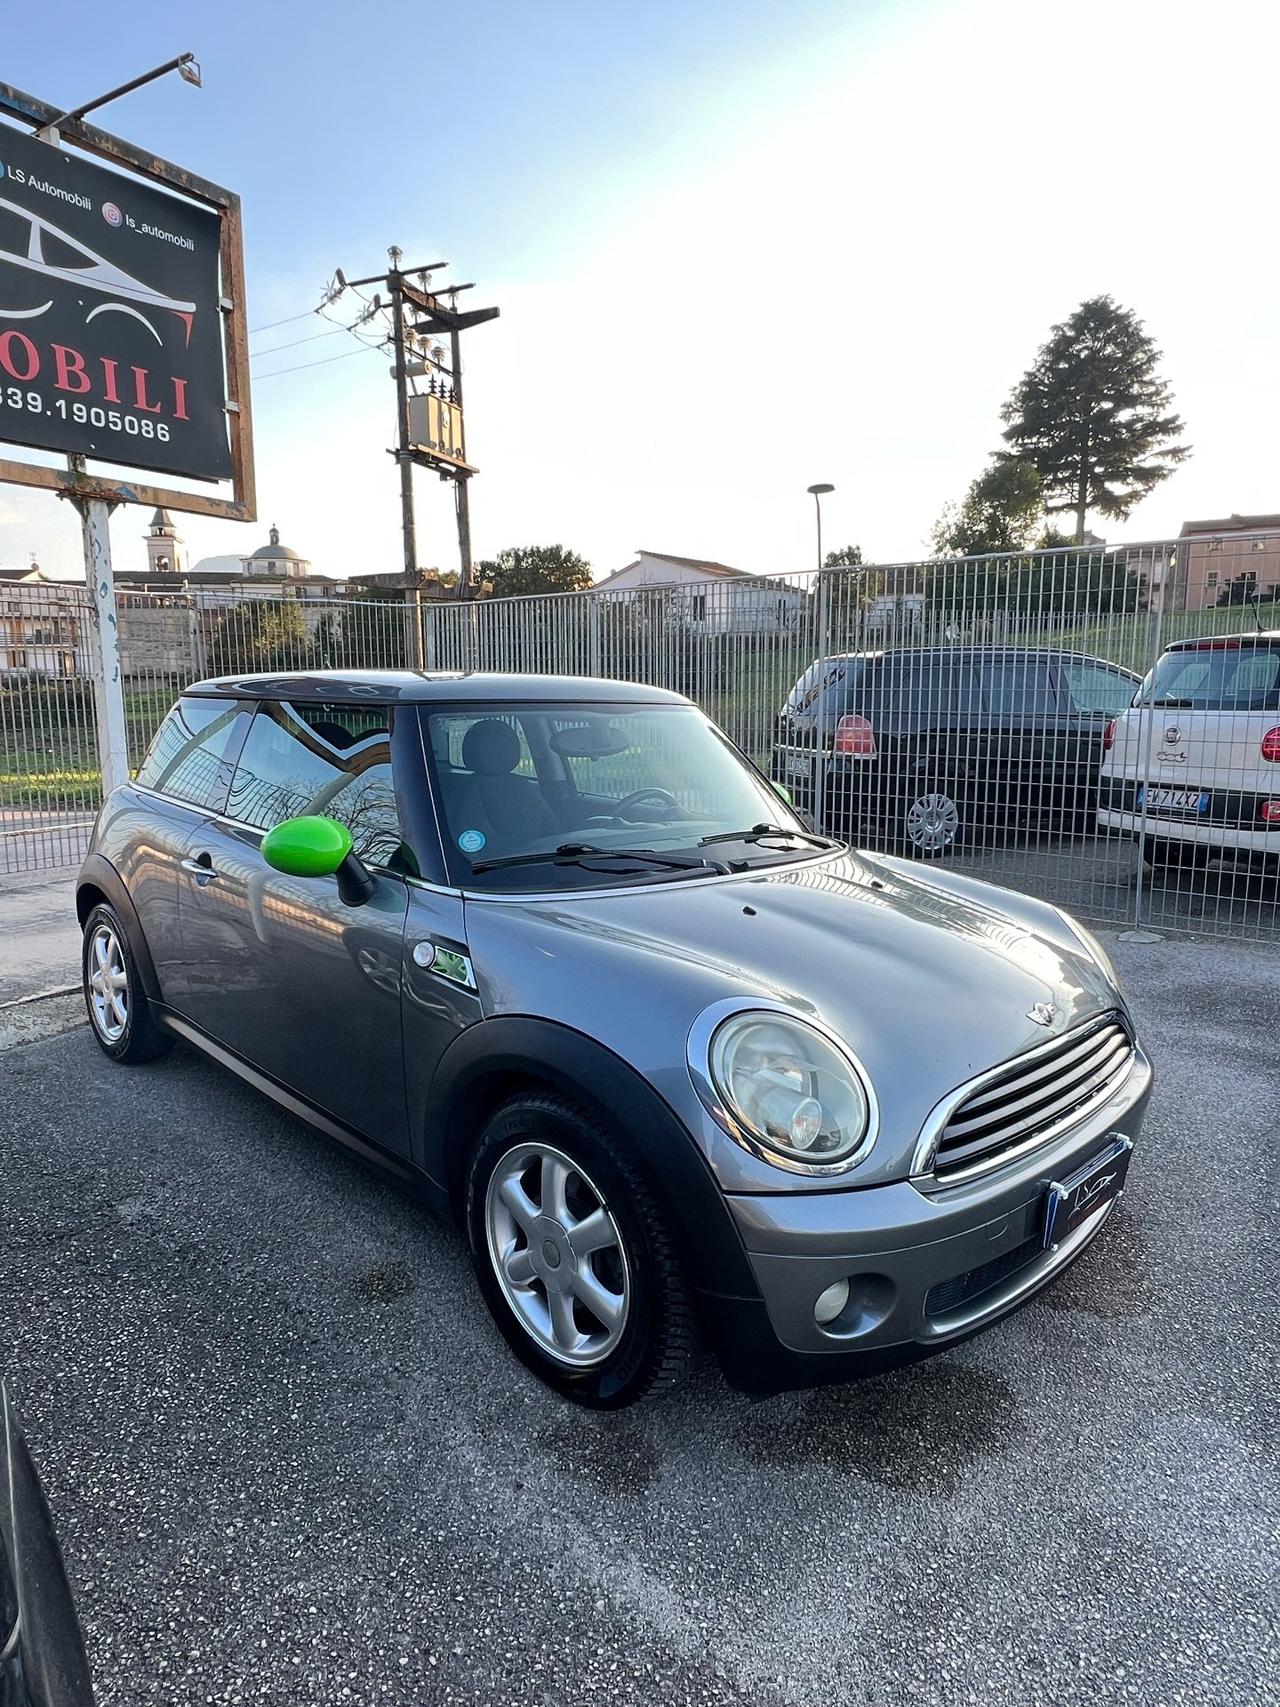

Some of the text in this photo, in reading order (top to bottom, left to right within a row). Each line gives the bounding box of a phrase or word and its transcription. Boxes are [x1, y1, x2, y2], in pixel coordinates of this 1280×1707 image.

[7, 165, 92, 211] LS Automobili
[125, 214, 195, 251] ls_automobili
[0, 387, 171, 442] 39.1905086
